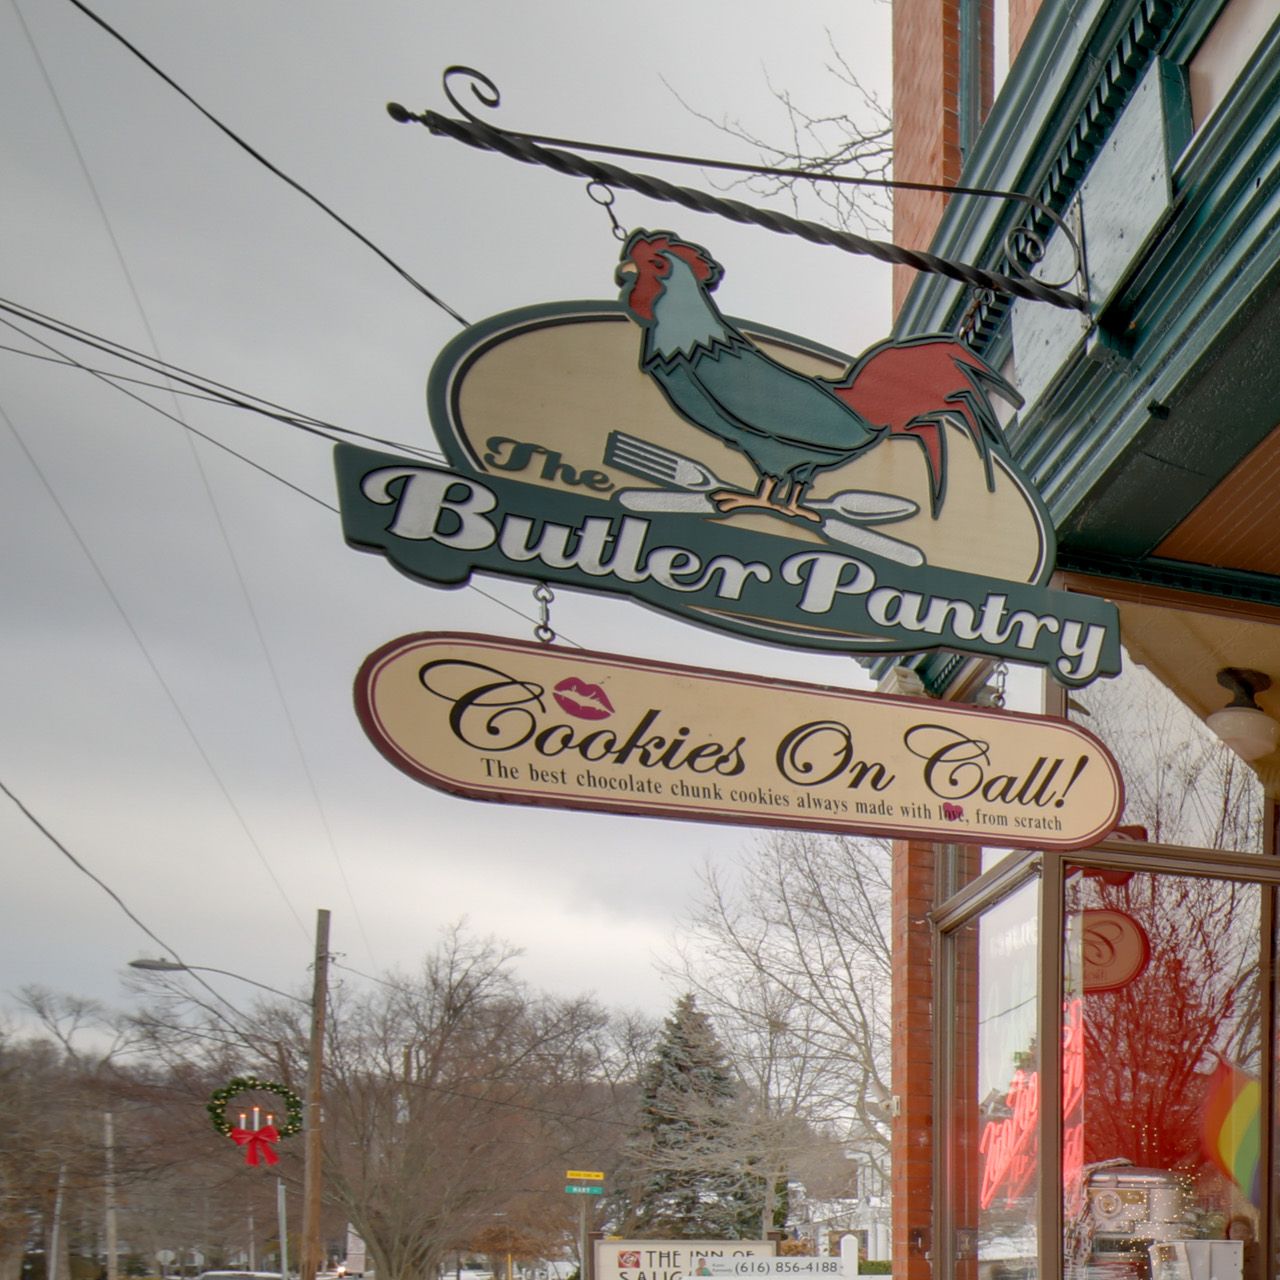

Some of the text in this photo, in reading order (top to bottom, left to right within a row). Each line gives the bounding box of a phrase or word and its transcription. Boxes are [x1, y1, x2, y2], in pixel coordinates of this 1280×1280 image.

[483, 436, 616, 491] The
[359, 464, 1107, 680] Butler Pantry
[418, 658, 1089, 809] Cookies On Call!
[481, 757, 520, 779] The
[529, 763, 568, 785] best
[576, 770, 662, 795] chocolate
[670, 779, 723, 800] chunk
[730, 788, 790, 808] cookies
[796, 795, 849, 817] always
[856, 800, 894, 816] made
[900, 803, 932, 820] with
[975, 809, 1008, 827] from
[1013, 814, 1062, 831] scratch
[645, 1250, 681, 1268] THE
[735, 1262, 770, 1275] (616)
[776, 1261, 837, 1273] 856-4188
